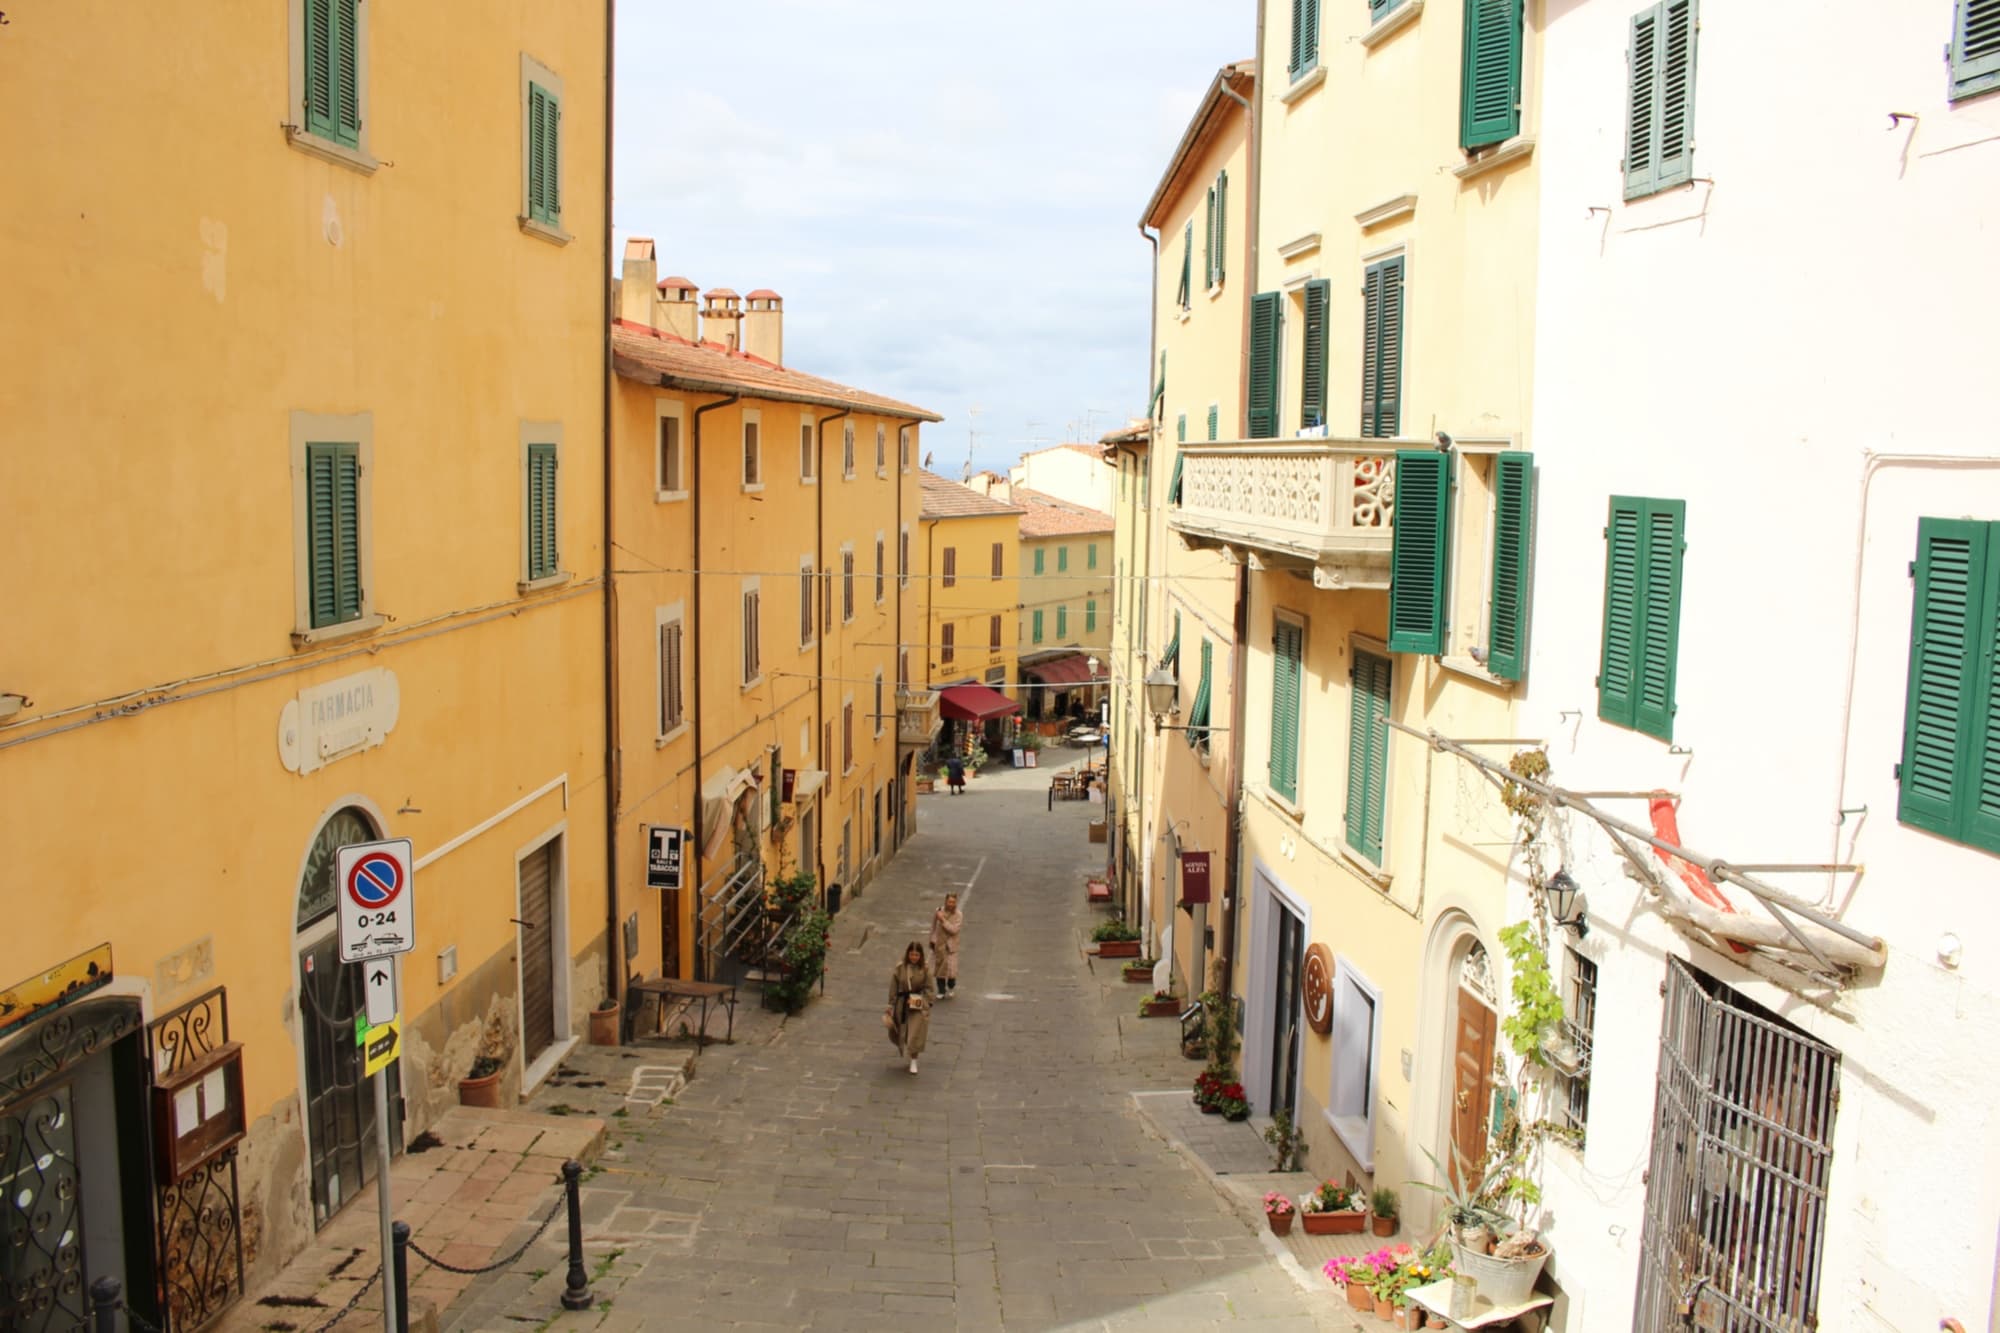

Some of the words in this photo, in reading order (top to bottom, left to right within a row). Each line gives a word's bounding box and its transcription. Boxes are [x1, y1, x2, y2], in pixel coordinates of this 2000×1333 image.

[311, 683, 374, 727] FARMACIA
[654, 830, 677, 859] T
[650, 864, 679, 872] TABACCHI
[358, 911, 396, 928] 0-24
